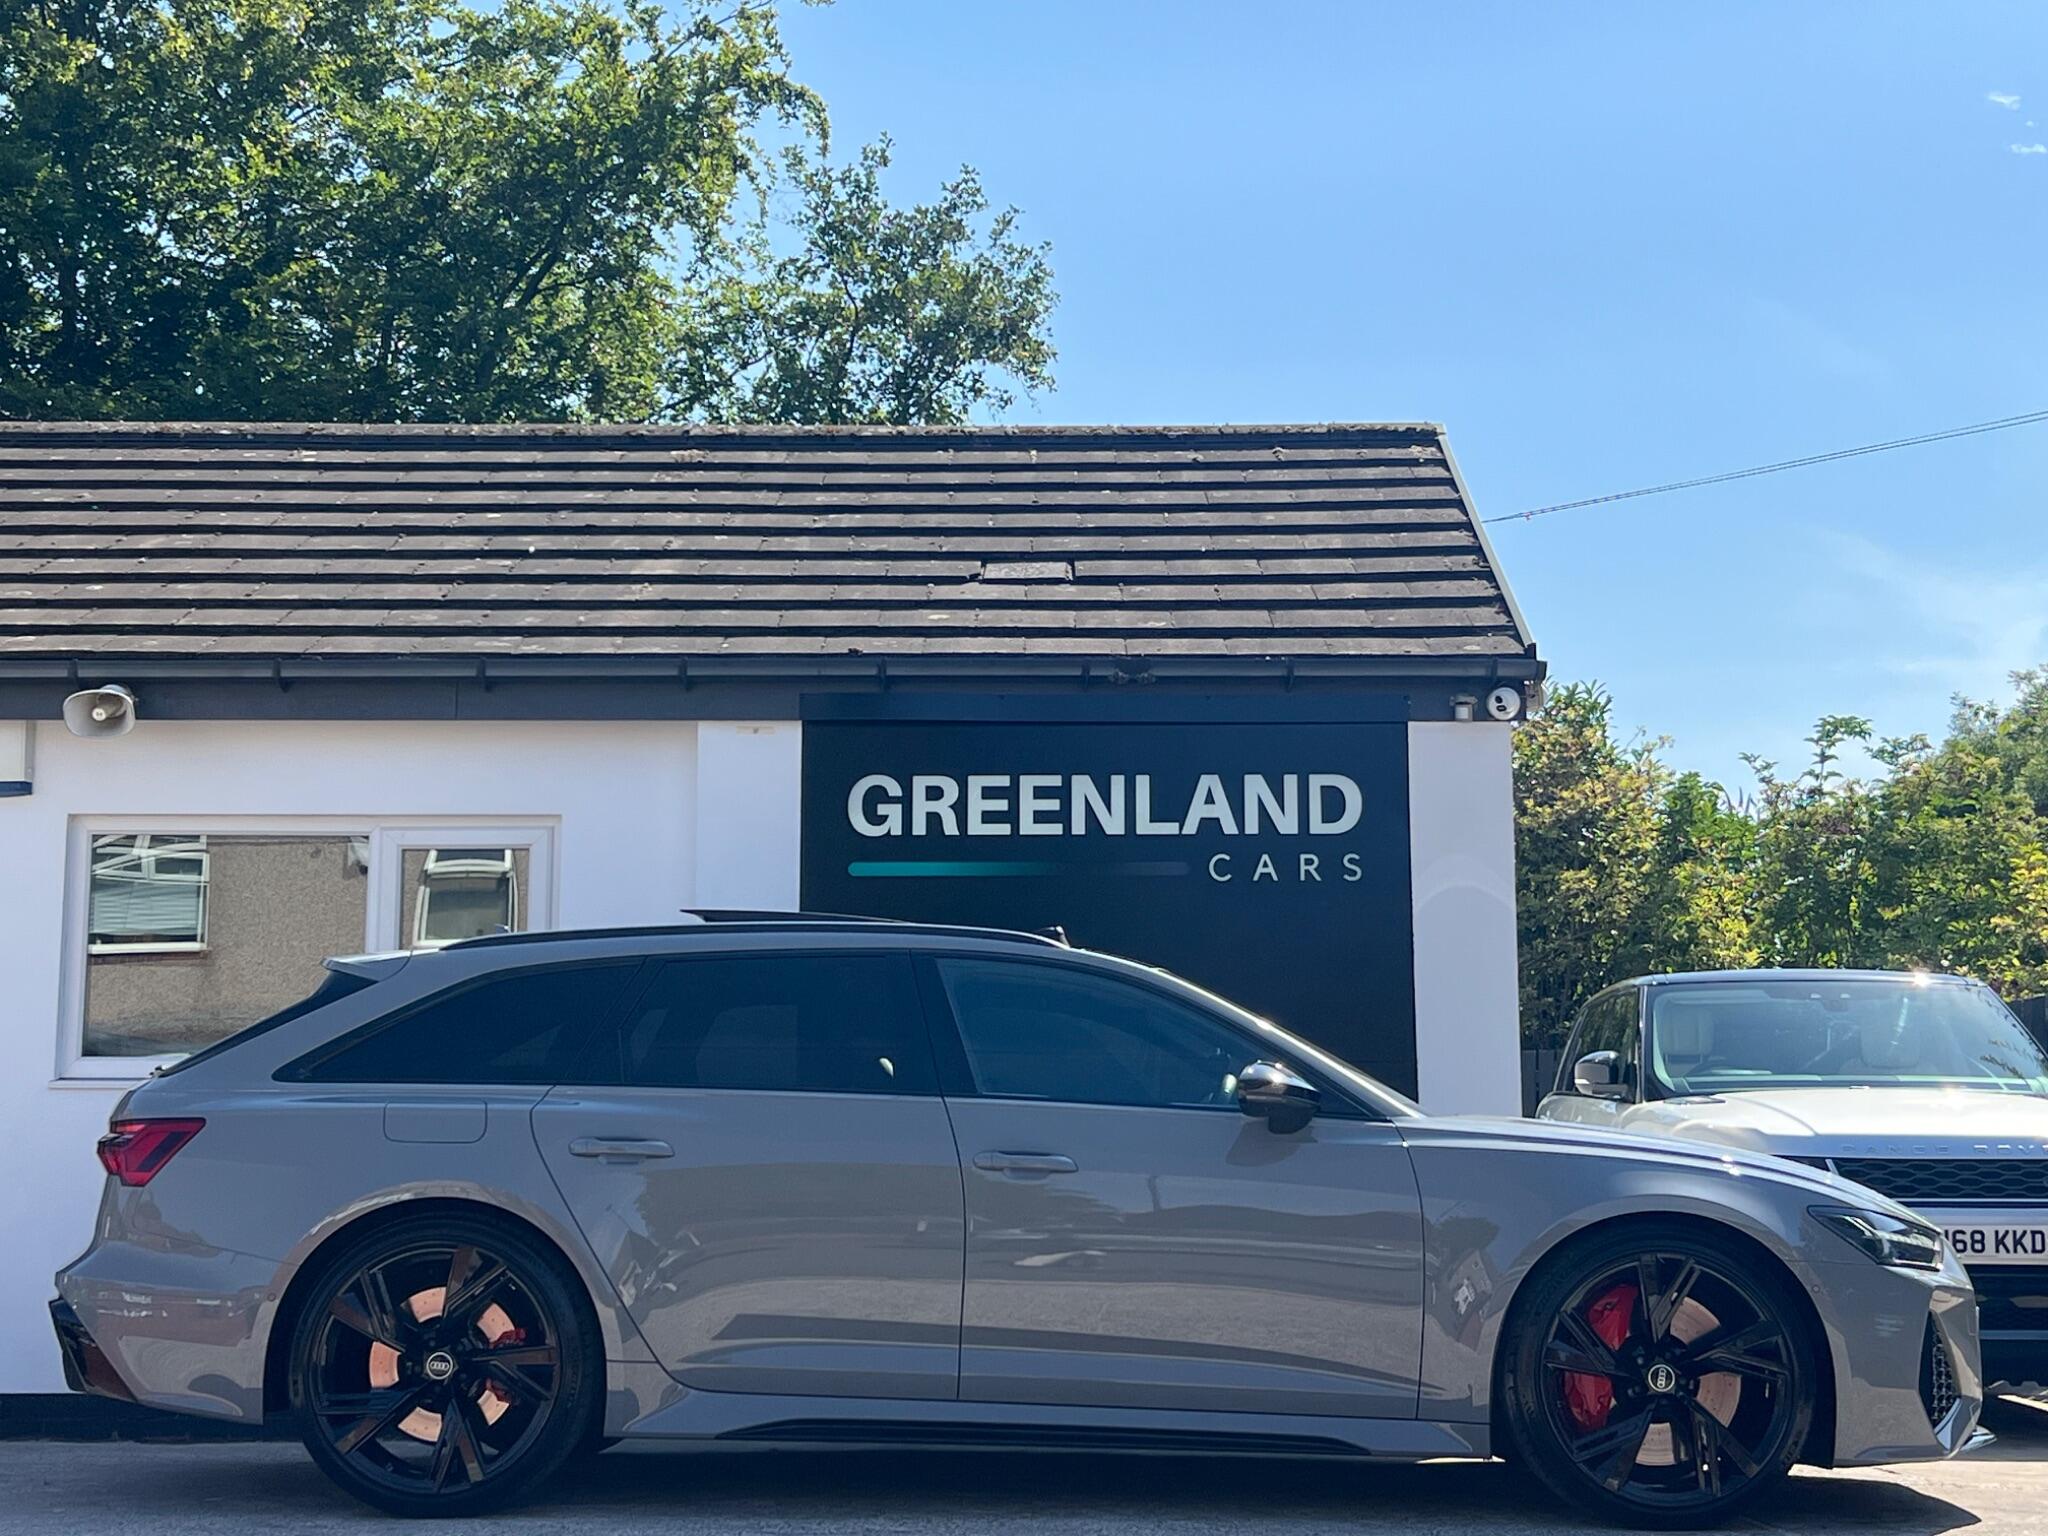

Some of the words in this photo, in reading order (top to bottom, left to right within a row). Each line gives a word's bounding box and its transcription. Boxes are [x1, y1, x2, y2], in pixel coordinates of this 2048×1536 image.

[848, 774, 1362, 836] GREENLAND
[1209, 854, 1361, 881] CARS
[1944, 1229, 1985, 1253] 68
[1995, 1229, 2046, 1254] KKD
